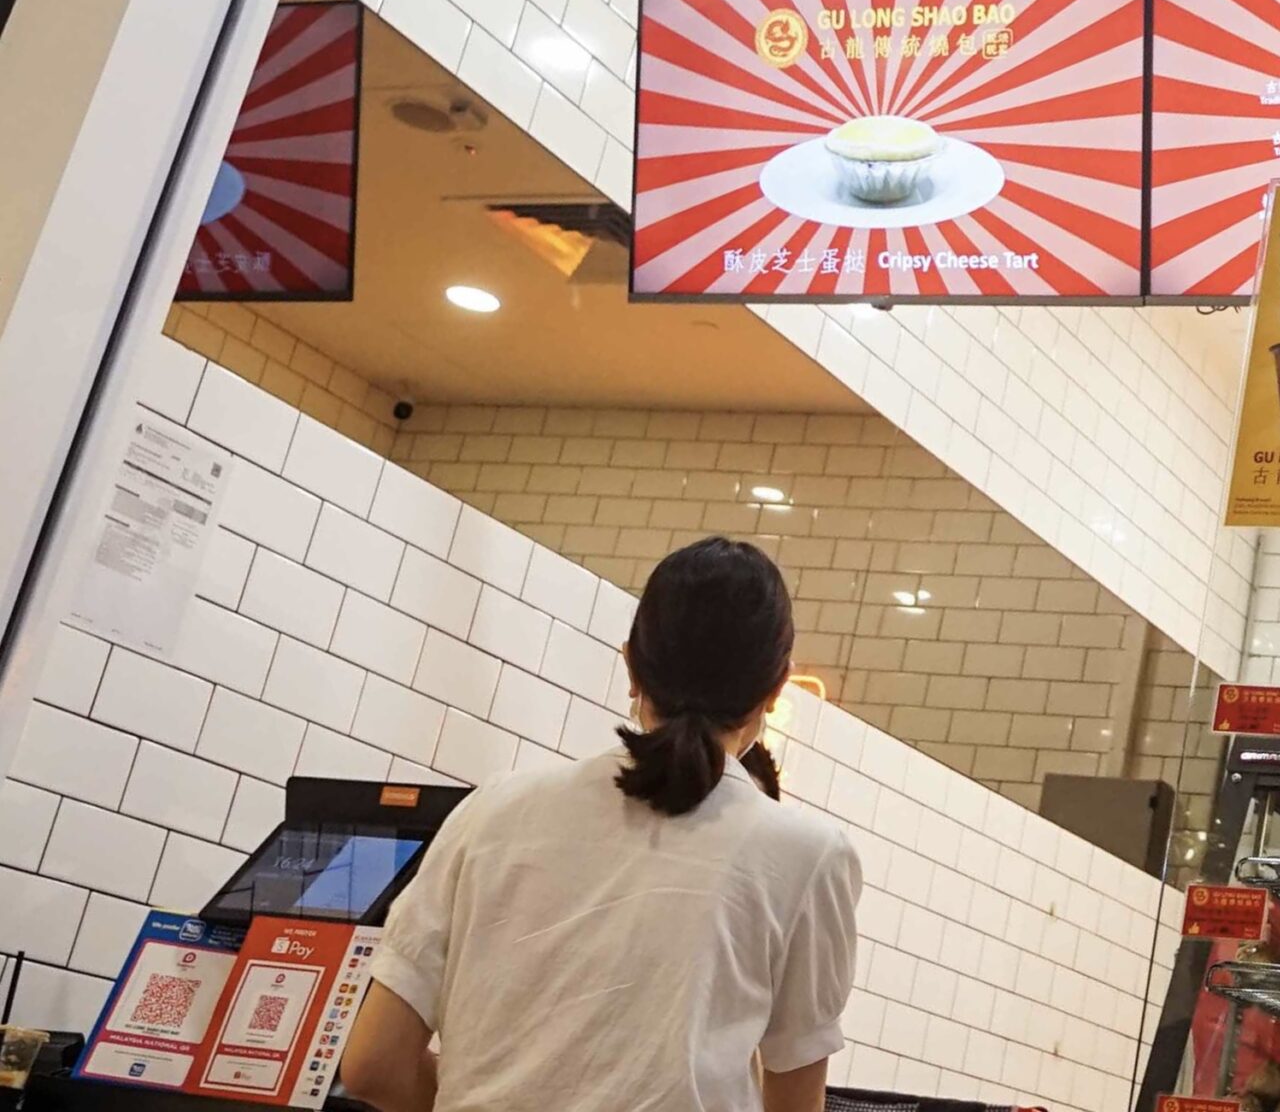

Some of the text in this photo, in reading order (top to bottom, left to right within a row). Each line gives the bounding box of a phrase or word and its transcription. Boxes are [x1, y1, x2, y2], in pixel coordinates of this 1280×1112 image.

[817, 3, 1015, 30] GU LONG SHAO BAO
[723, 248, 1040, 274] 酥皮芝士蛋挞 Cripsy Cheese Tart
[1253, 451, 1274, 464] GU
[288, 940, 315, 961] Pay
[109, 1034, 142, 1044] MALAYSIA
[143, 1039, 178, 1050] NATIONAL
